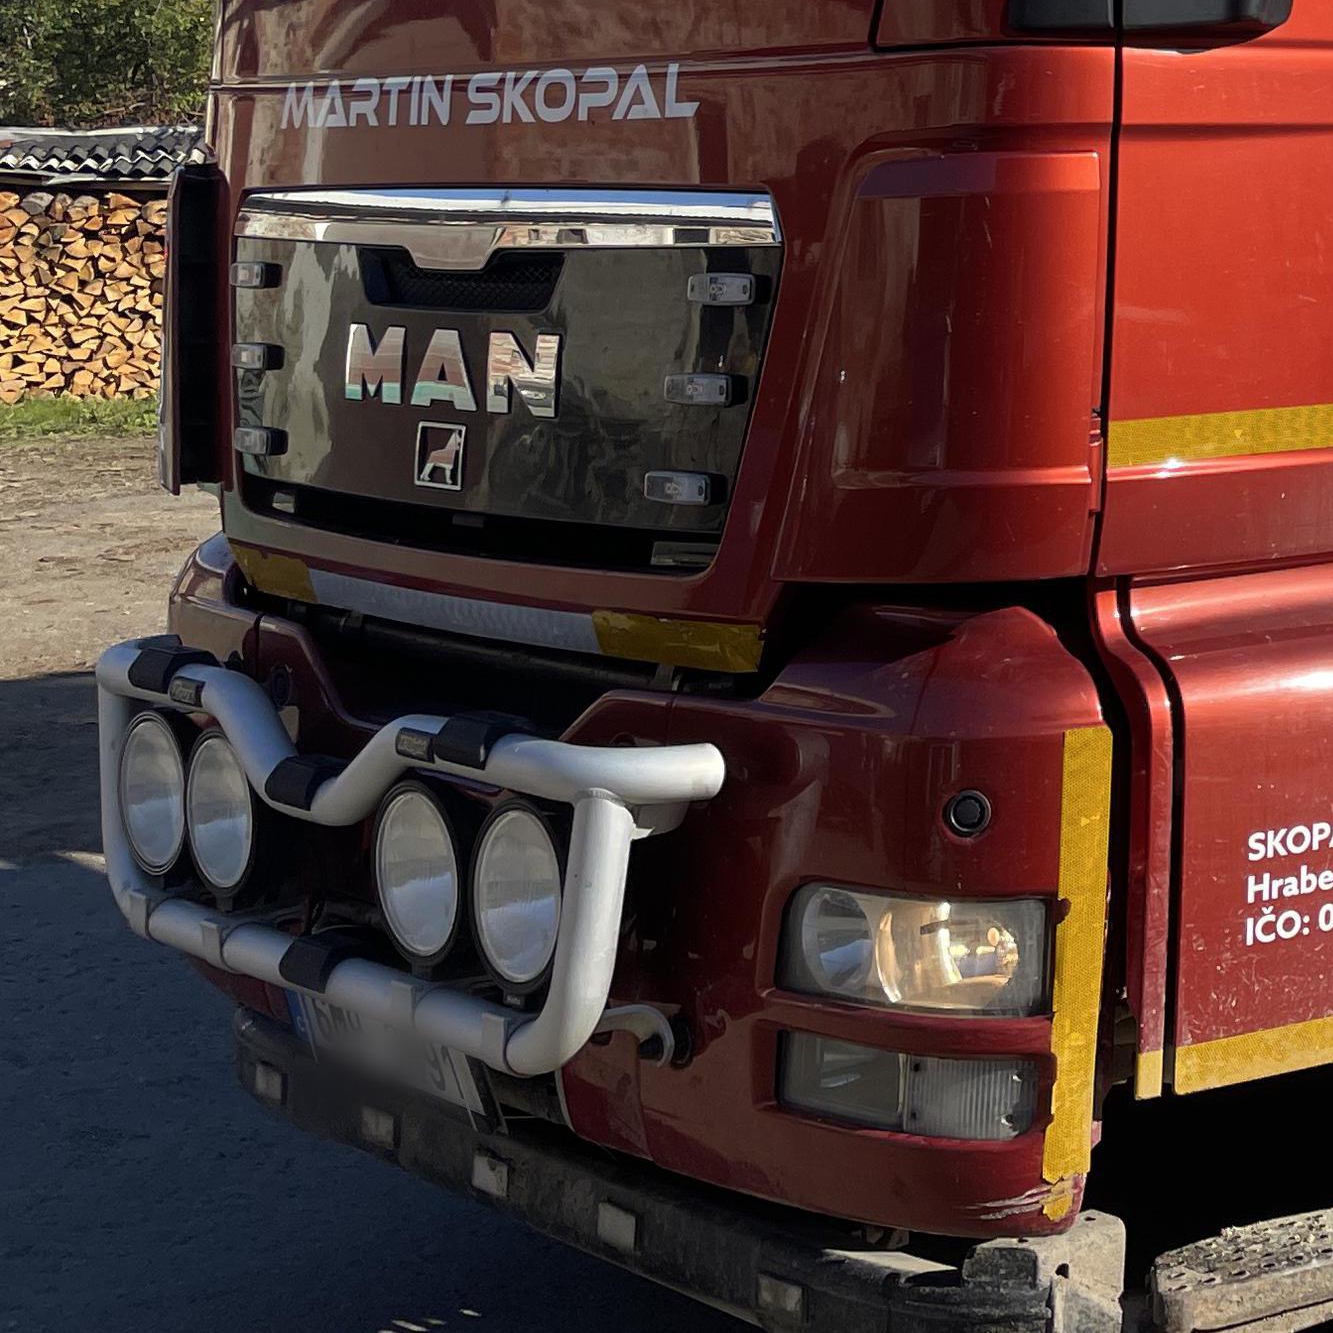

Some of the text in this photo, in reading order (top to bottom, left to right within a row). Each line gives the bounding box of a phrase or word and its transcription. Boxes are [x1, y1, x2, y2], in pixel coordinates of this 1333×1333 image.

[280, 63, 700, 129] MARTIN SKOPAL
[344, 323, 563, 418] MAN
[1245, 906, 1310, 946] IČO:
